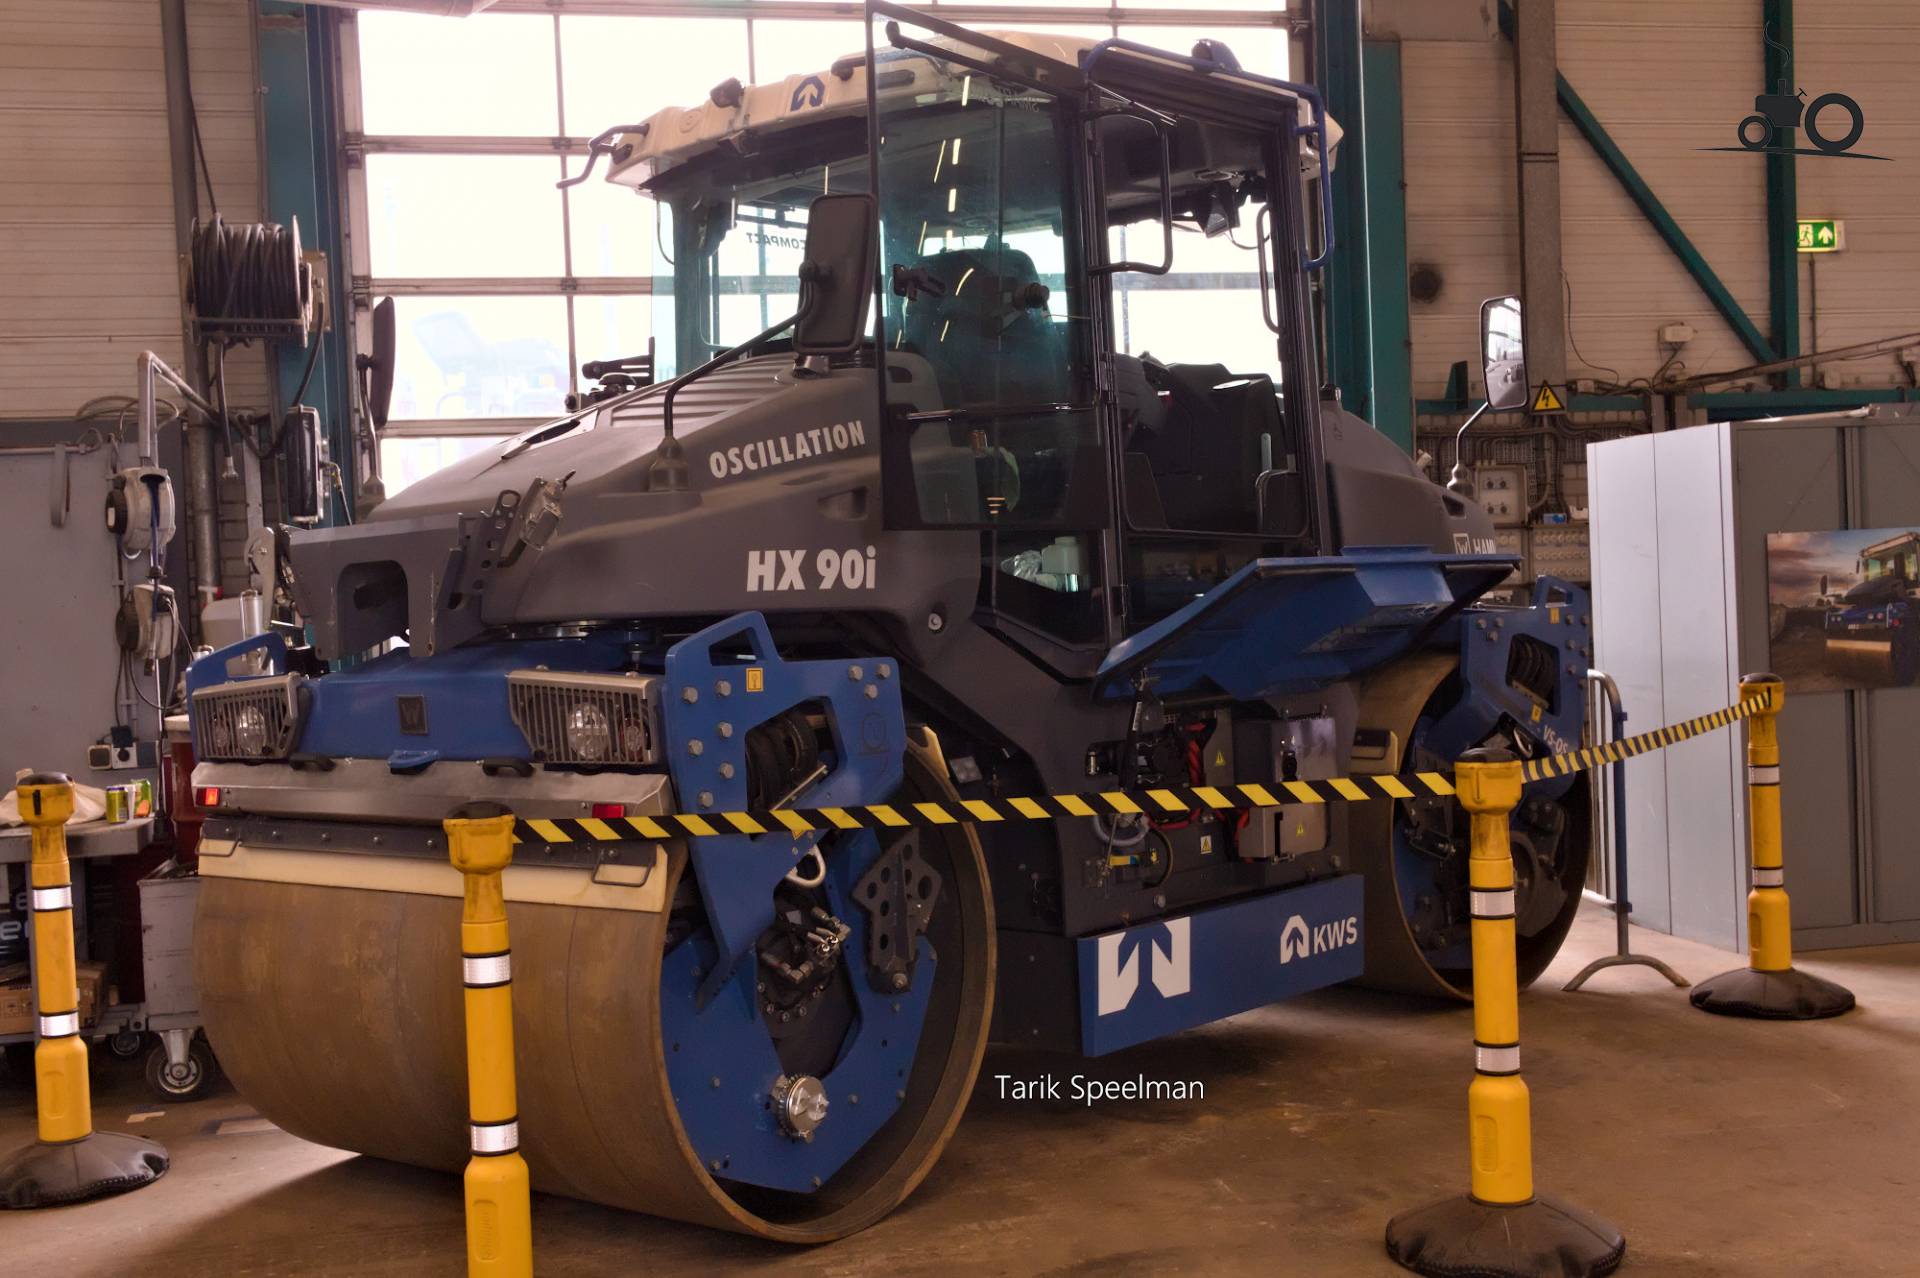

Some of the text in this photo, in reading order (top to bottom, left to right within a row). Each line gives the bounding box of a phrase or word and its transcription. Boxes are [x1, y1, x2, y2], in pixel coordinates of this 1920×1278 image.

[709, 420, 866, 479] OSCILLATION
[746, 545, 877, 592] HX 90i
[1313, 916, 1358, 955] KWS
